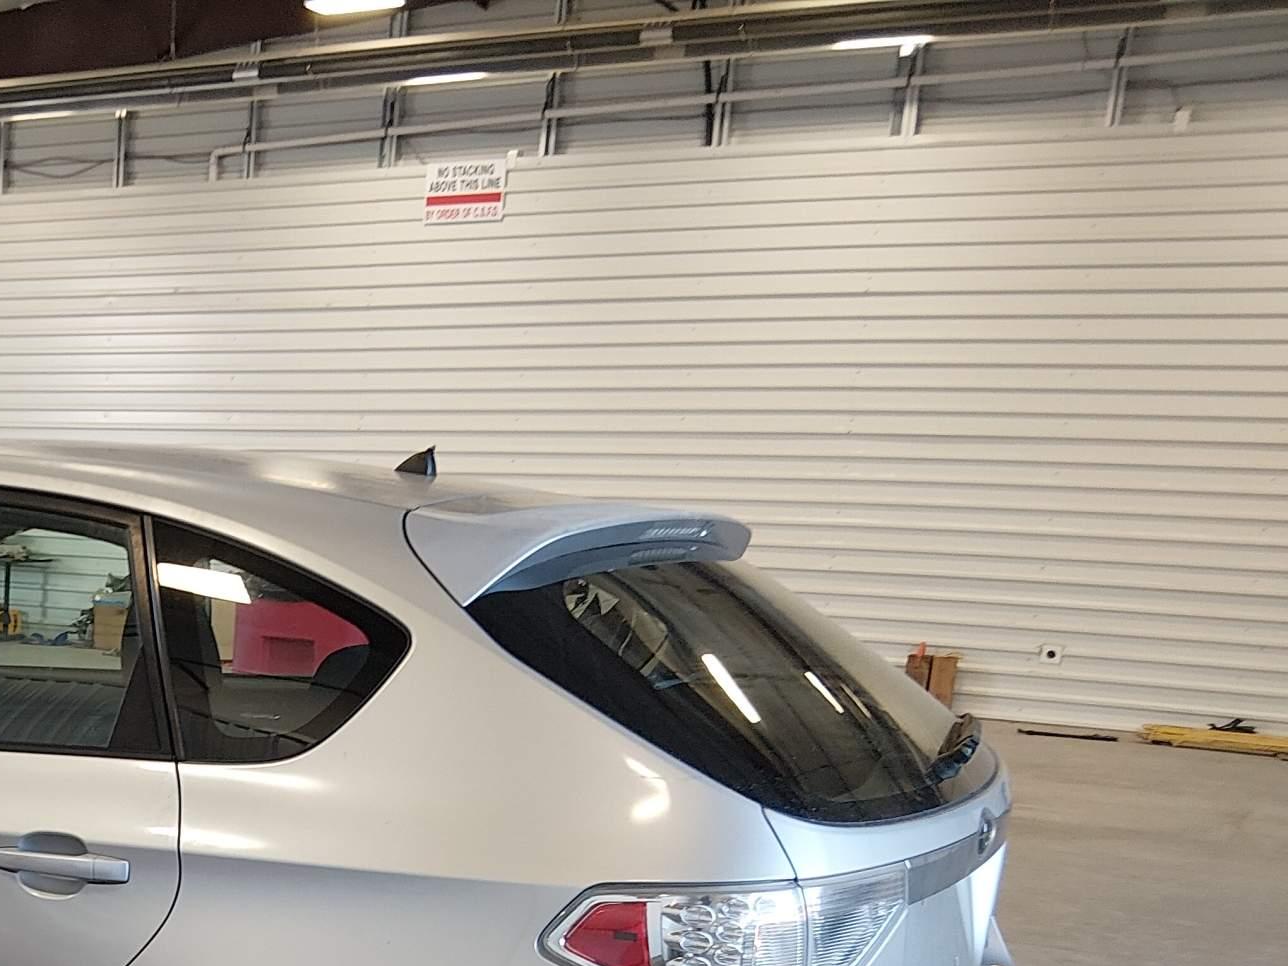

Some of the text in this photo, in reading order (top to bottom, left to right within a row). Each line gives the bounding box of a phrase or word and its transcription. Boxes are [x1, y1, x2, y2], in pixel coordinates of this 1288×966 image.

[437, 163, 494, 178] NO STACKING
[428, 176, 502, 193] ABOVE THIS LINE
[436, 208, 460, 220] ORDER
[462, 207, 472, 218] OF
